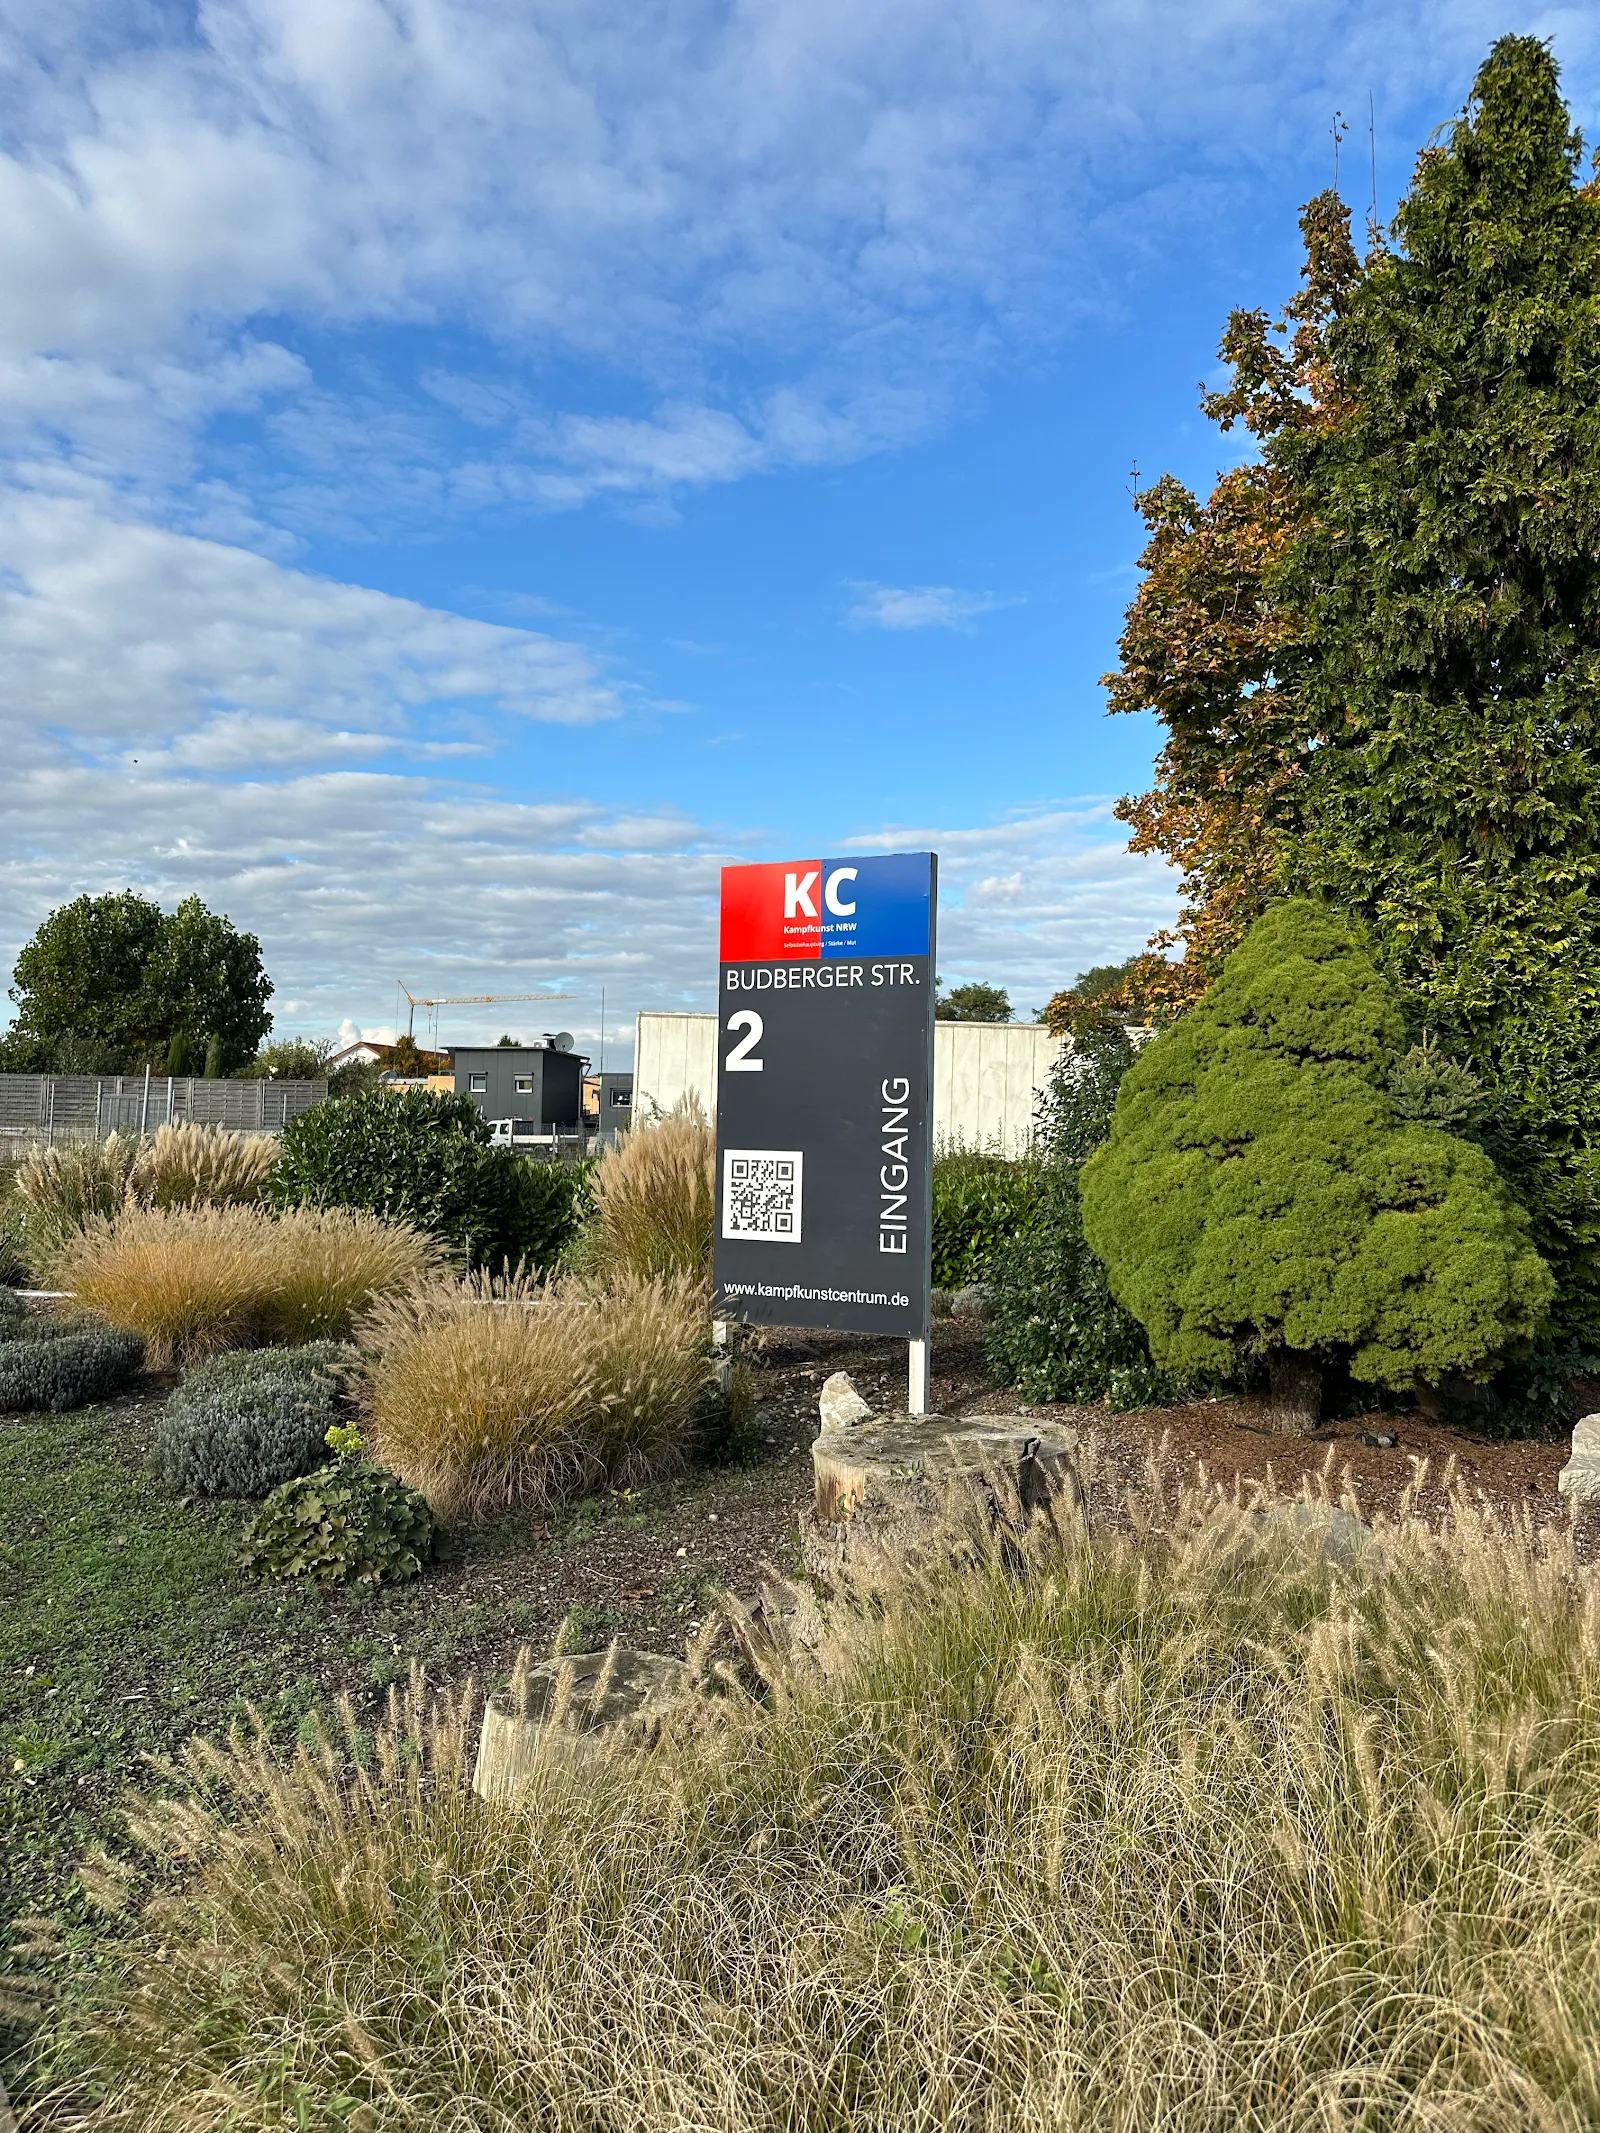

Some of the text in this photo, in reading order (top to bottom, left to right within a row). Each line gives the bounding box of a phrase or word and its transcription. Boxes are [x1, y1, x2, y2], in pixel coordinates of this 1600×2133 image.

[783, 922, 858, 935] Kampfkunst NRW
[726, 963, 921, 991] BUDBERGER STR.
[725, 1010, 764, 1072] 2
[879, 1077, 911, 1254] EINGANG
[724, 1282, 909, 1306] www.kampfkunstcentrum.de
